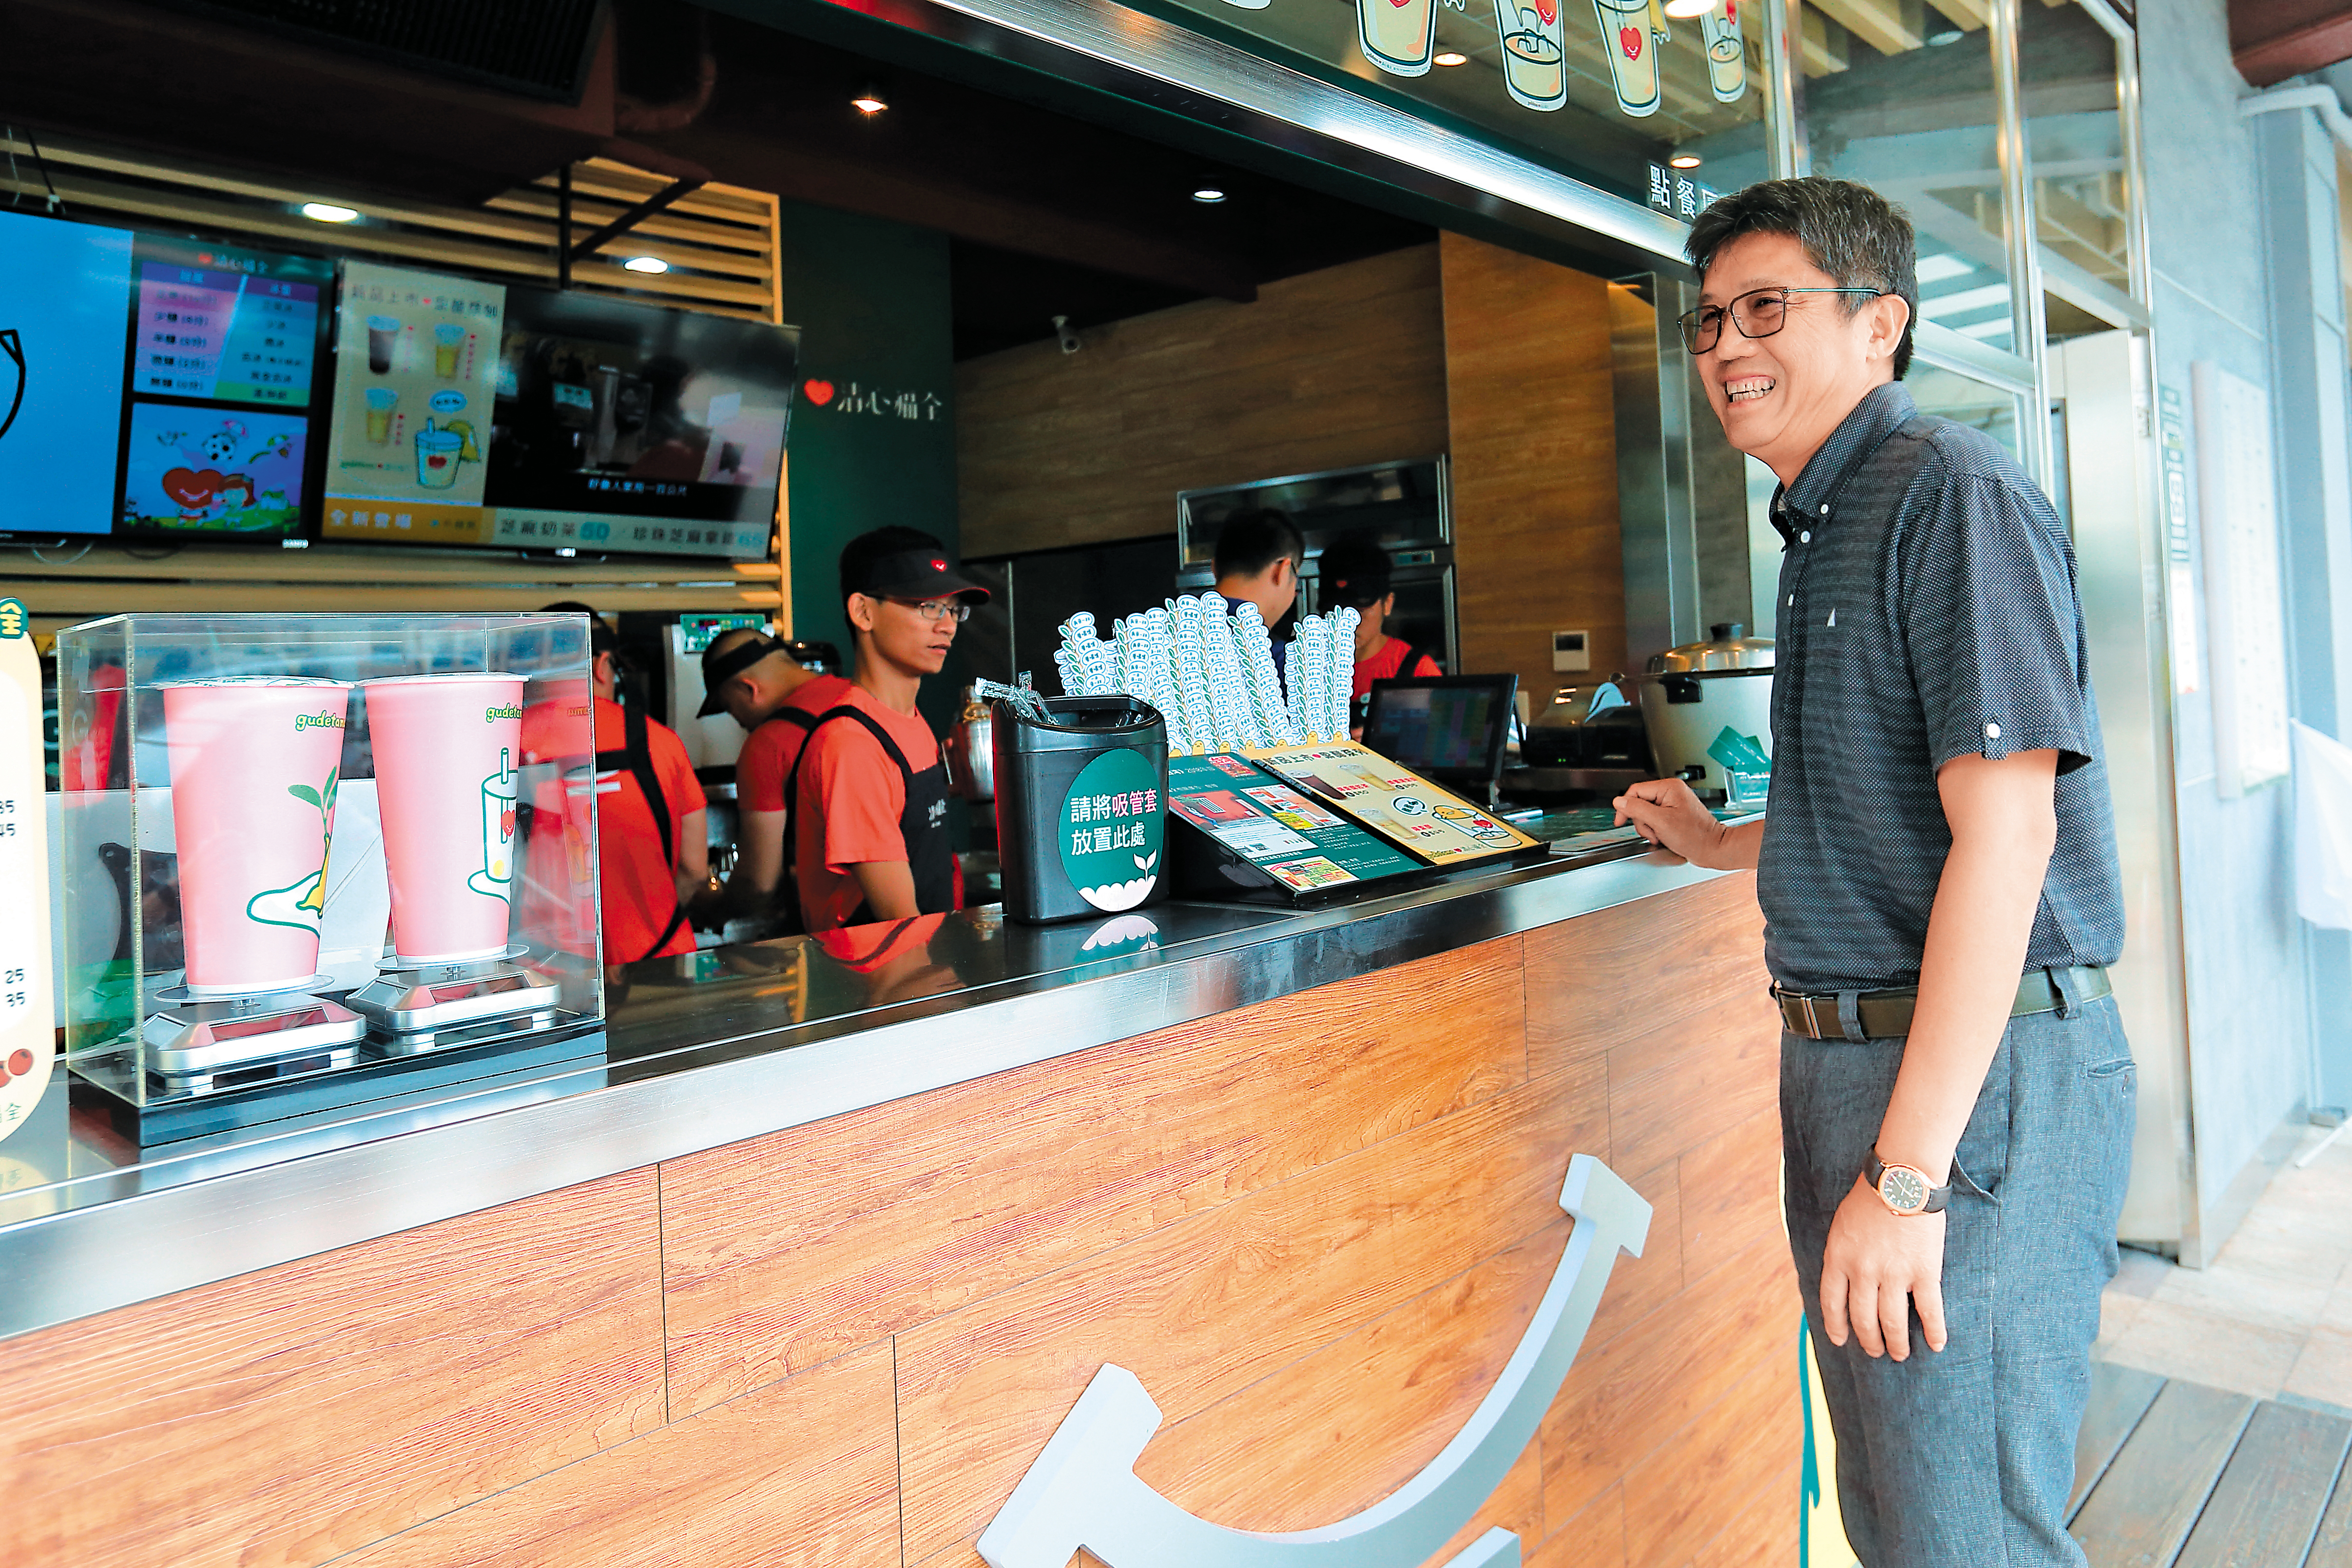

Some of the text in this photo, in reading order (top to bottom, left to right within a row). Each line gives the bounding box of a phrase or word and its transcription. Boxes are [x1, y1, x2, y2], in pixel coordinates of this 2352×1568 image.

[1070, 788, 1157, 824] 請將吸管套
[1071, 821, 1147, 856] 放置此處
[5, 968, 24, 984] 25
[5, 991, 25, 1007] 35
[0, 1103, 22, 1122] 全
